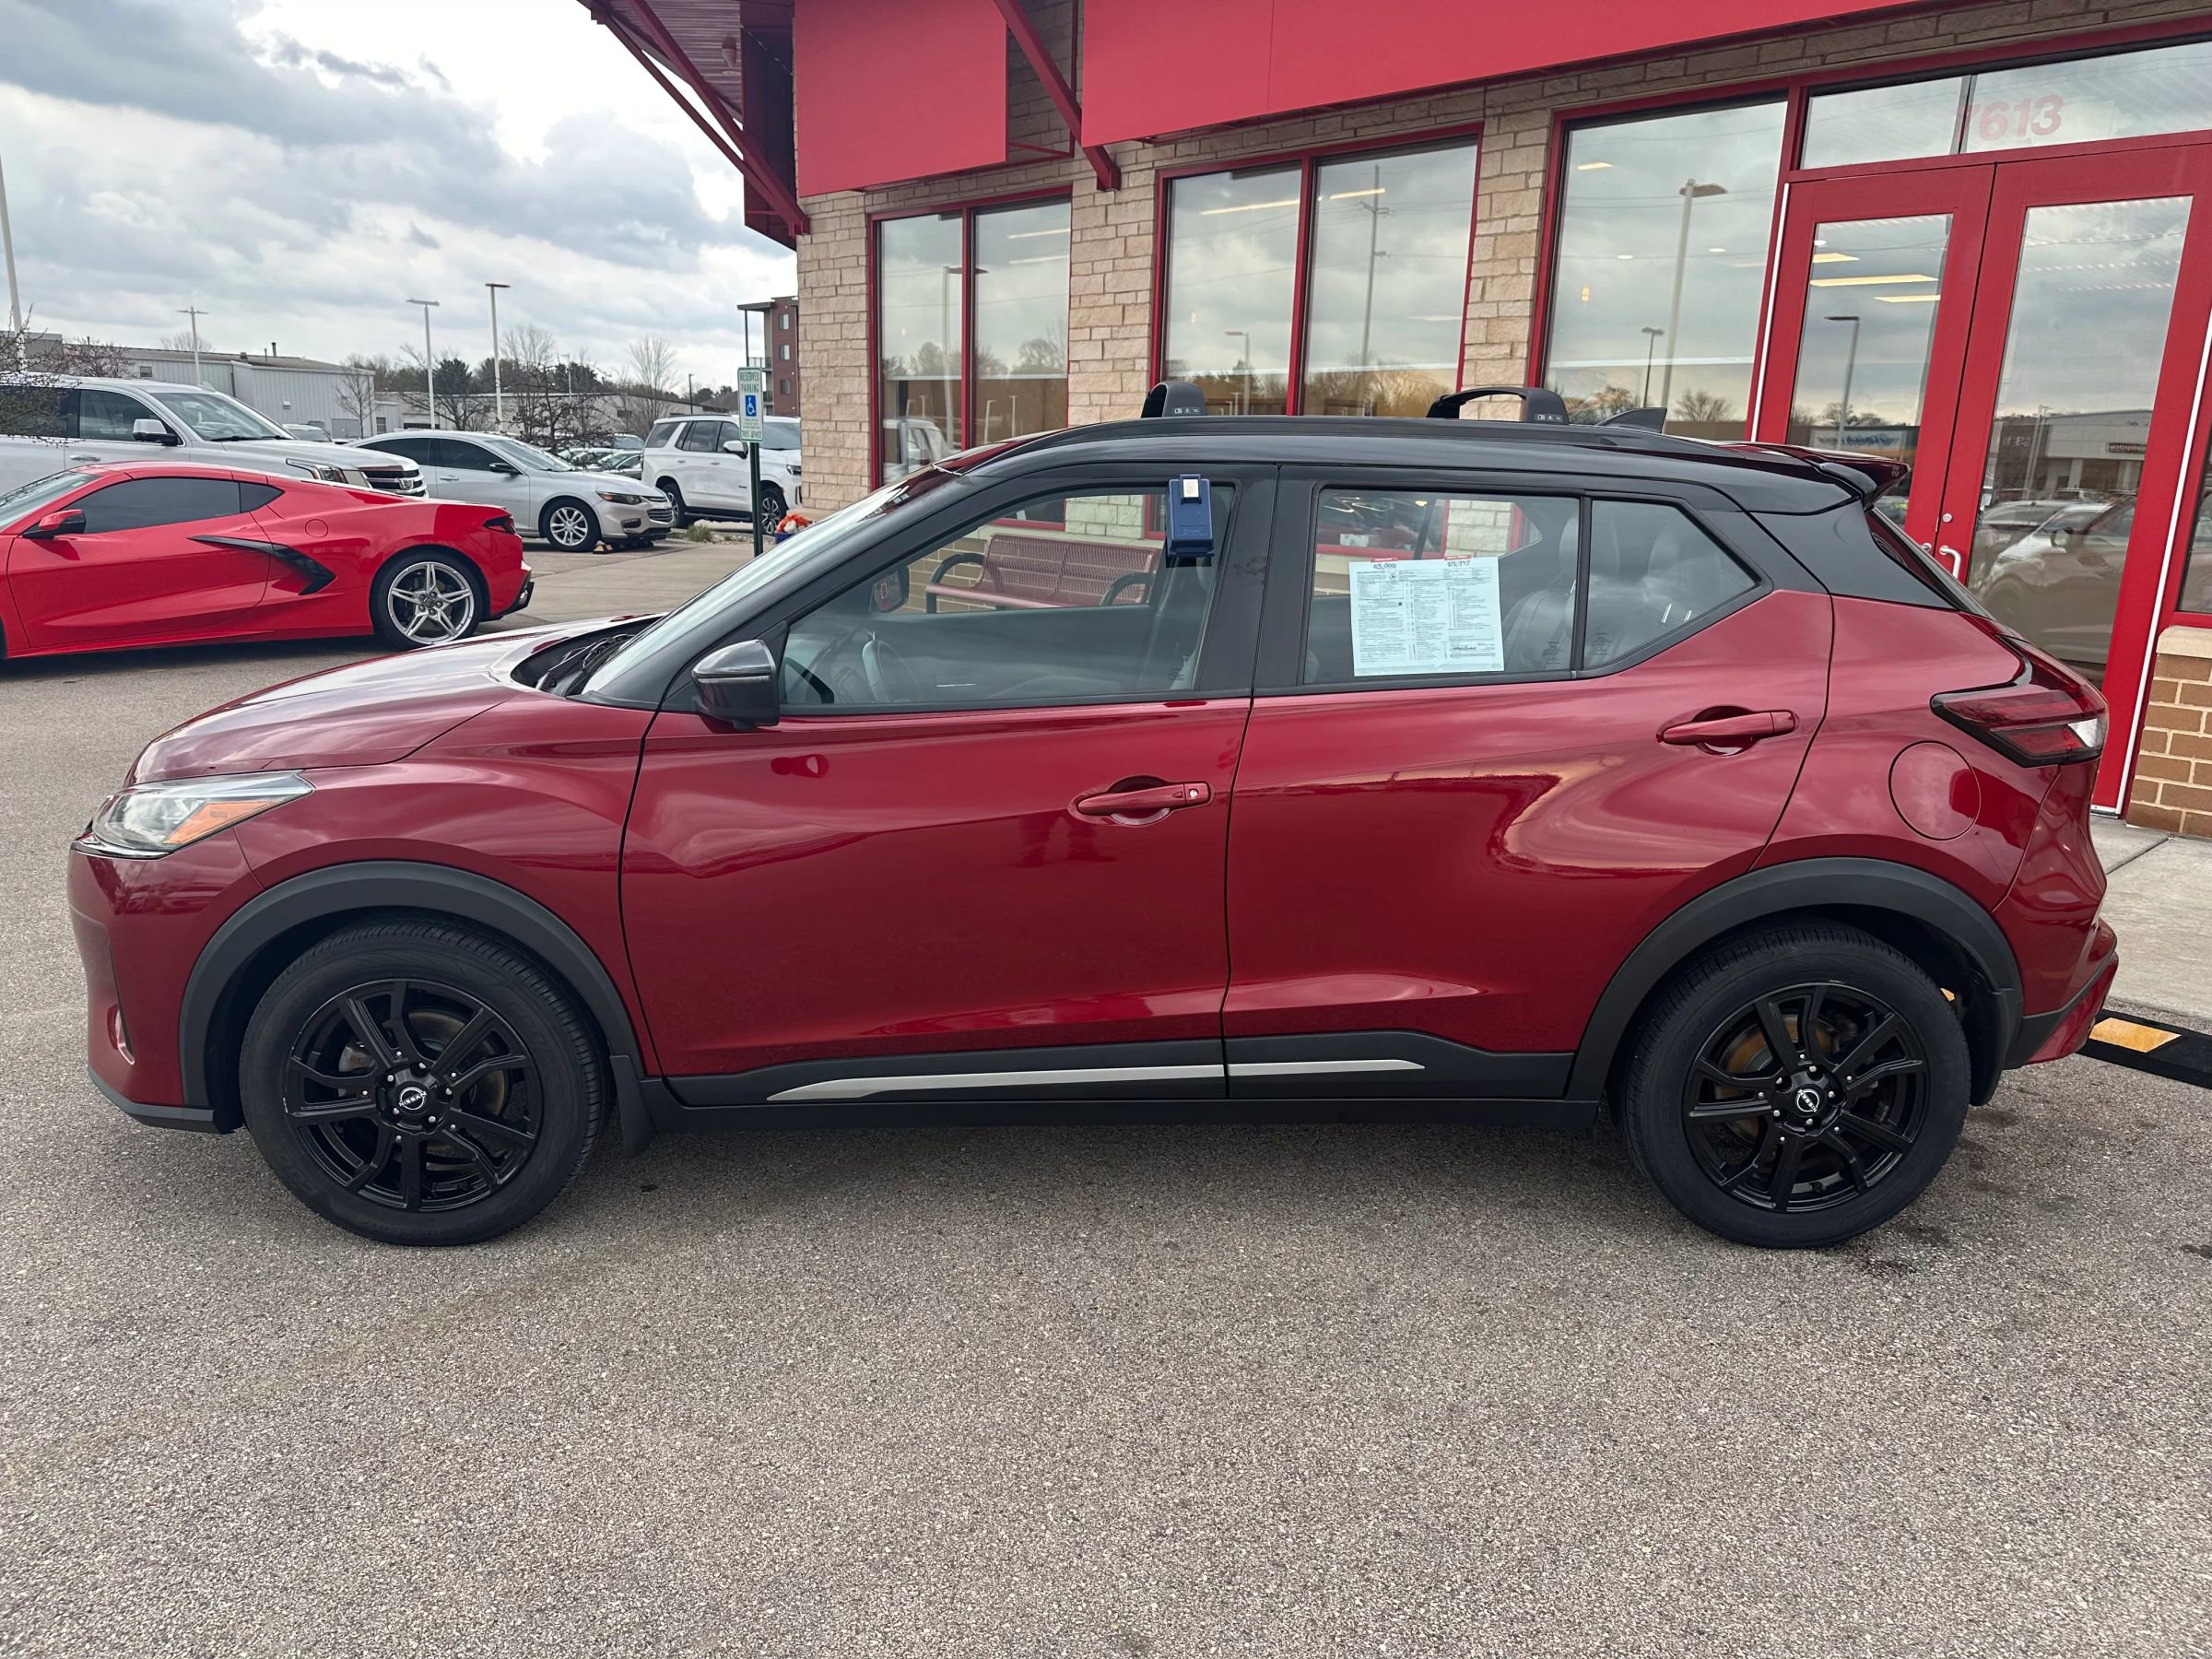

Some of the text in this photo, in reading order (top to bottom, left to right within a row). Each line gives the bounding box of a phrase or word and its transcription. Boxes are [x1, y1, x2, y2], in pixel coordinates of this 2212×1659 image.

[740, 371, 759, 382] RESERVED
[741, 383, 759, 393] PARKING
[398, 1090, 428, 1107] NISSAN
